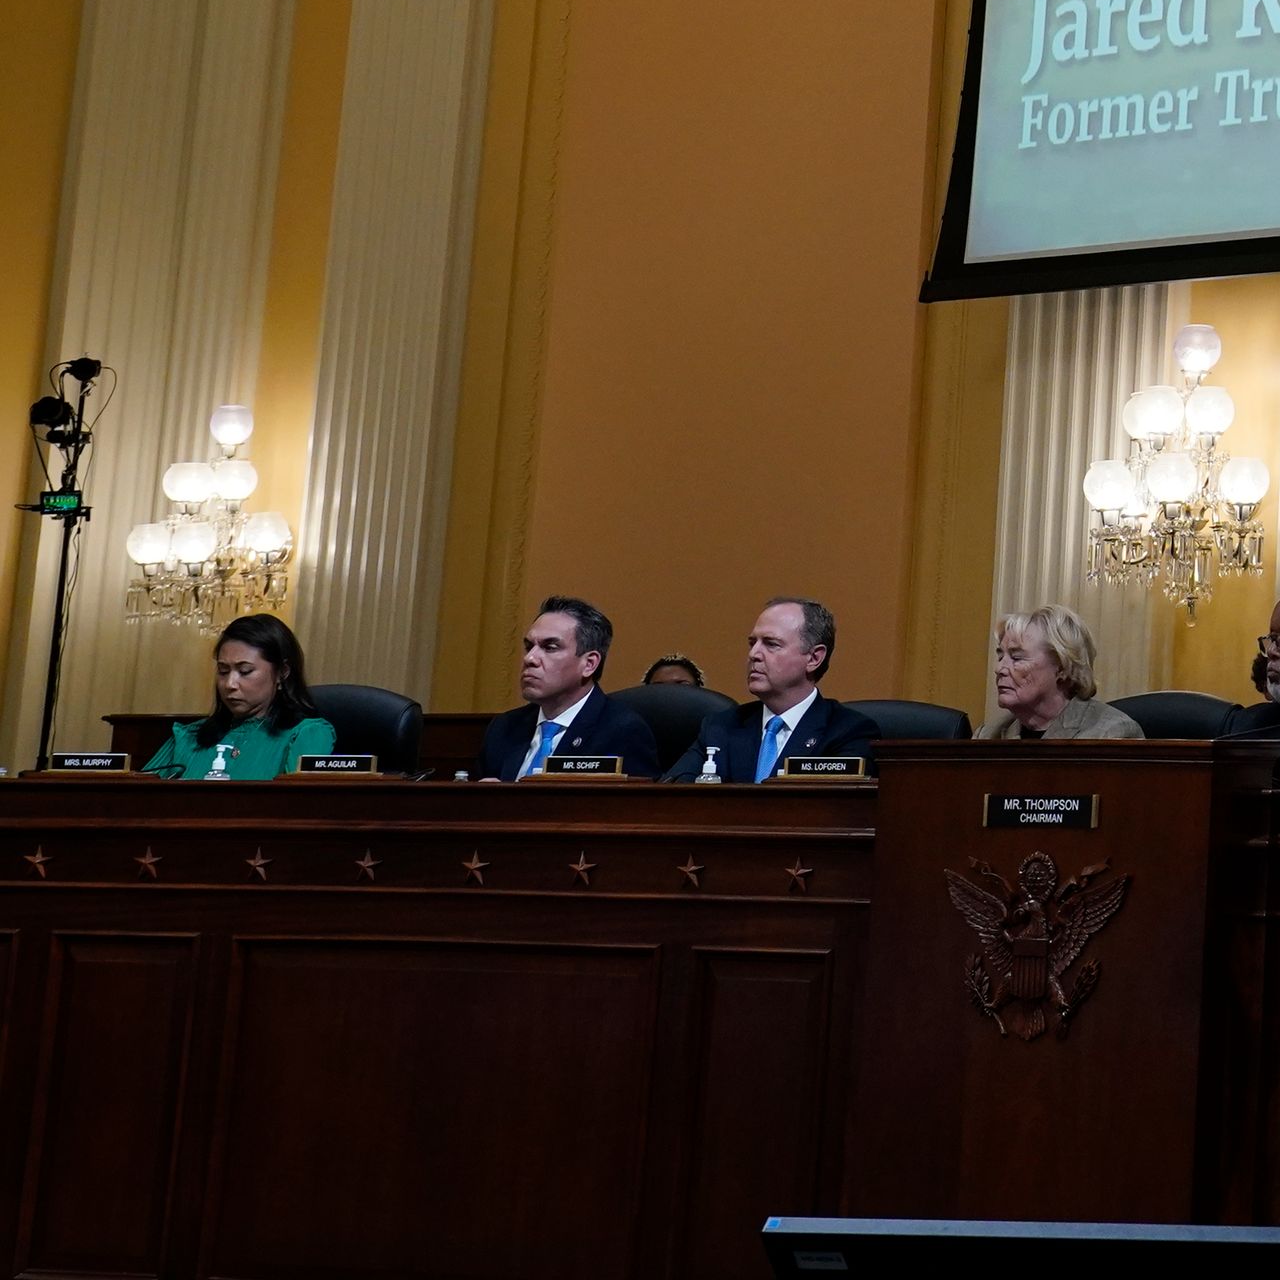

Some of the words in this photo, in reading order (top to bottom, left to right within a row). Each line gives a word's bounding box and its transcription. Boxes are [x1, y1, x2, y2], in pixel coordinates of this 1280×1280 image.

[1017, 84, 1199, 150] Former
[64, 758, 81, 767] MRS.
[82, 757, 113, 767] MURPHY
[327, 759, 357, 769] AGUILAR
[562, 761, 575, 770] MR.
[576, 760, 601, 770] SCHIFF
[801, 762, 813, 771] MS.
[814, 761, 847, 771] LOFGREN
[1003, 798, 1022, 811] MR.
[1025, 798, 1080, 812] THOMPSON
[1019, 813, 1063, 824] CHAIRMAN
